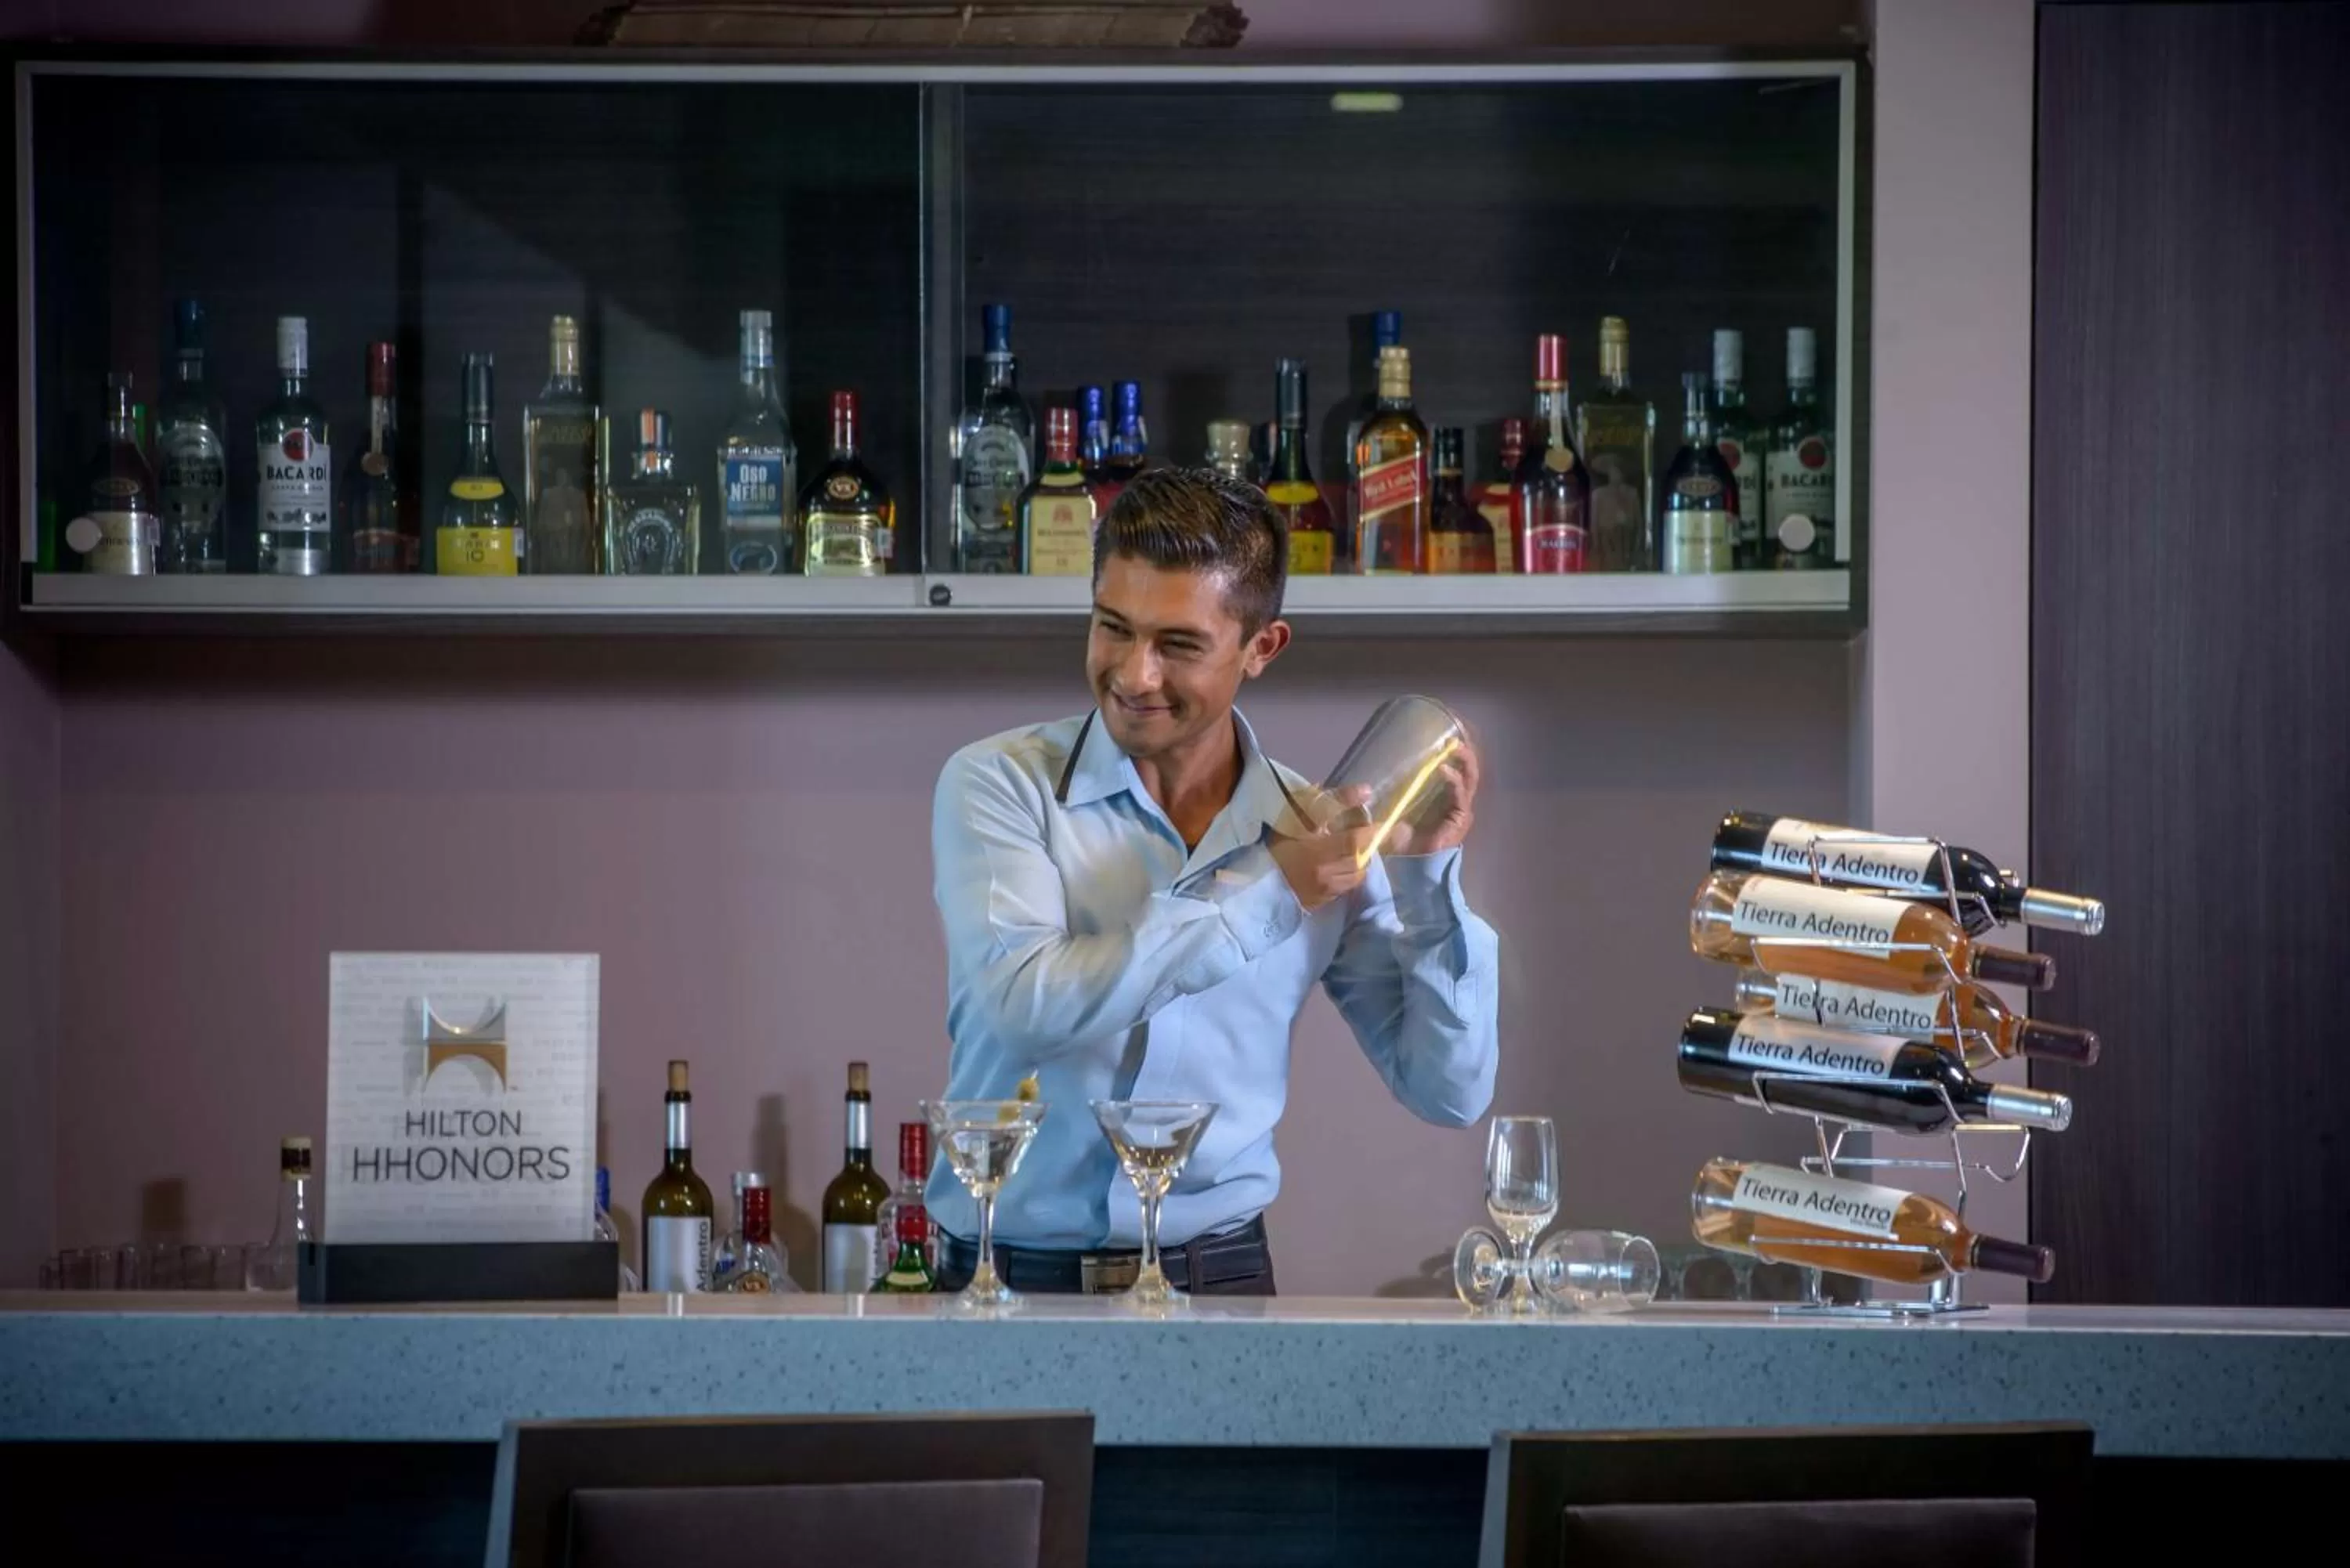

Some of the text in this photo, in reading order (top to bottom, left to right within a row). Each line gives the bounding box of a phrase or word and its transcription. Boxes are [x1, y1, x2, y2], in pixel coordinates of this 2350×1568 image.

[739, 463, 768, 483] OSO
[1781, 472, 1834, 490] BACAR
[730, 482, 777, 502] NEGRO
[1832, 853, 1918, 884] Adentro
[1741, 901, 1890, 943] Tierra Adentro
[1782, 983, 1931, 1029] Tierra Adentro
[1737, 1033, 1885, 1075] Tierra Adentro
[405, 1109, 522, 1138] HILTON
[352, 1146, 571, 1181] HHONORS
[1743, 1177, 1891, 1223] Tierra Adentro
